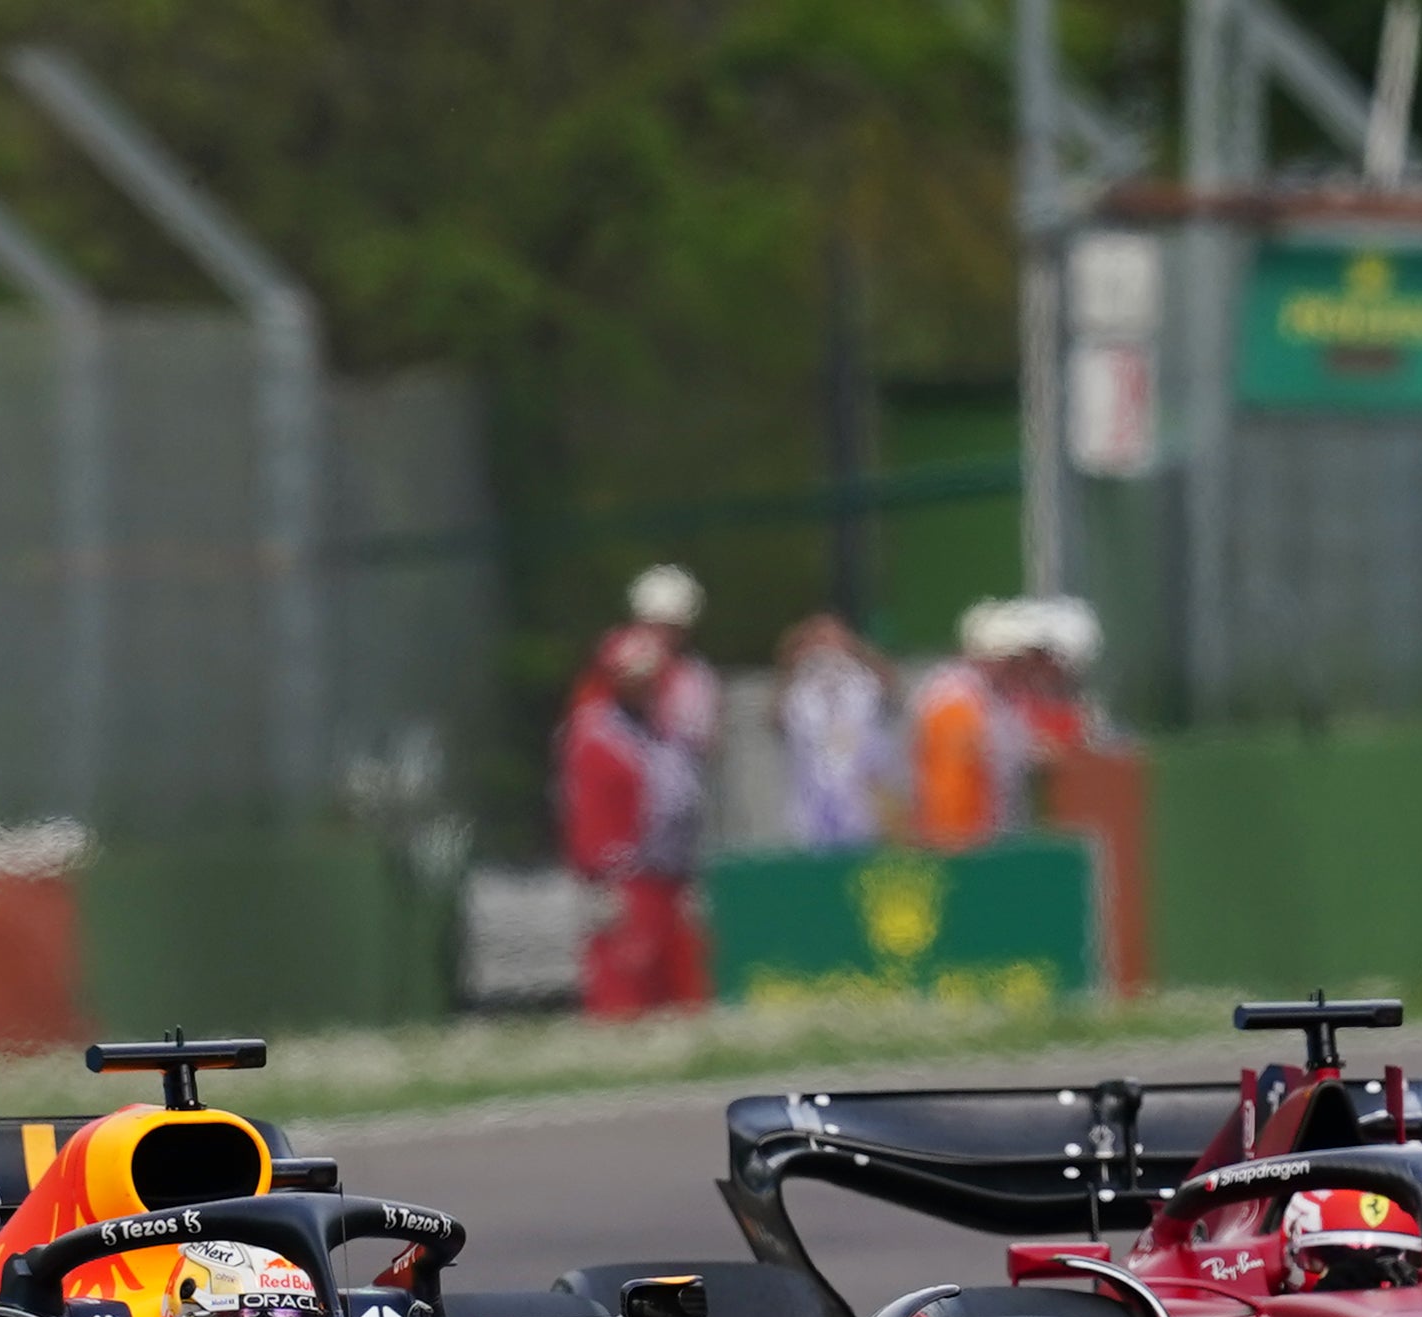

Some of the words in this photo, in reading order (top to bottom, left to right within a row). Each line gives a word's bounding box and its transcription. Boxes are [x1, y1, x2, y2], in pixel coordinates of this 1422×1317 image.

[1221, 1160, 1311, 1187] Snapdragon
[120, 1217, 179, 1241] Tezos
[398, 1207, 440, 1234] Tezos
[1200, 1250, 1266, 1281] Ray-Ban
[259, 1273, 291, 1289] Red
